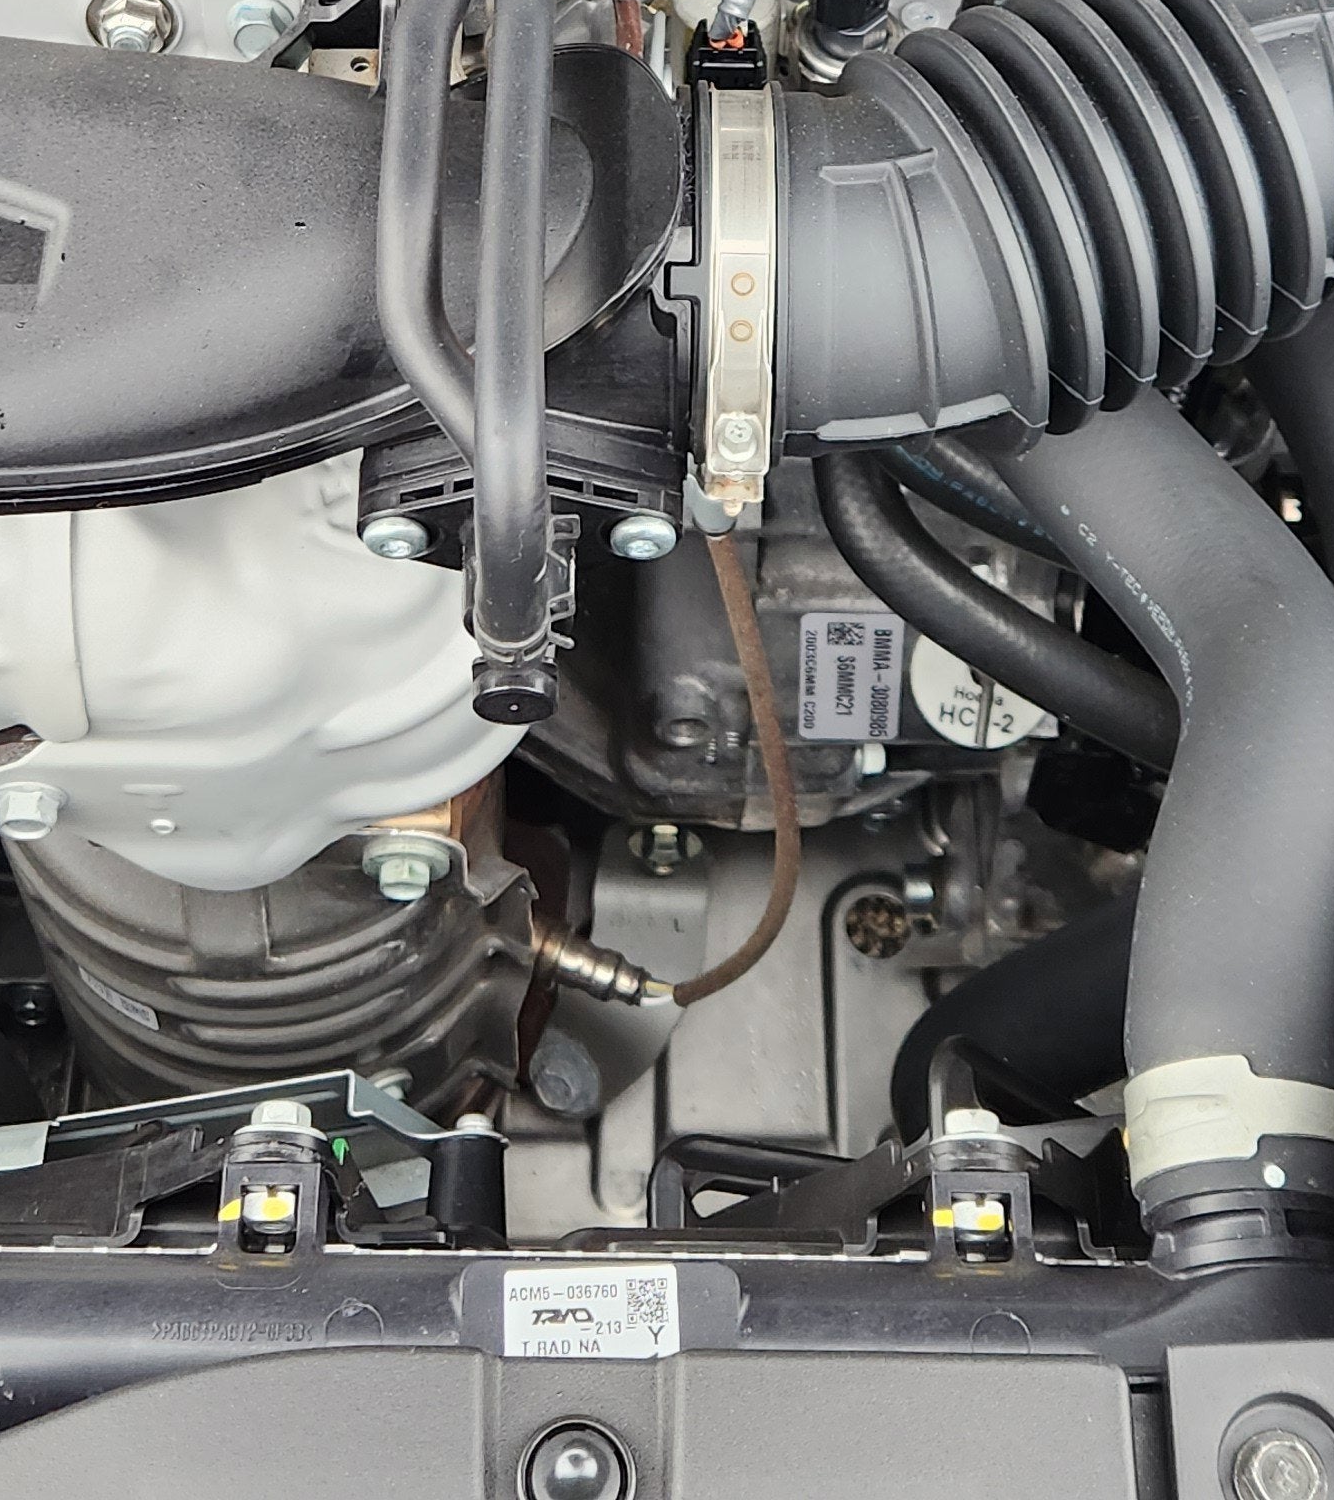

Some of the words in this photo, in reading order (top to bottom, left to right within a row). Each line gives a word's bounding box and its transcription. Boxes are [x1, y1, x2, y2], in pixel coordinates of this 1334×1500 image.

[835, 655, 856, 716] S6MMC21
[955, 684, 1004, 706] Hoa
[803, 701, 817, 729] C200
[939, 703, 1015, 735] HC-2
[522, 1339, 572, 1357] T.RAD
[579, 1339, 602, 1354] NA
[648, 1325, 666, 1346] Y
